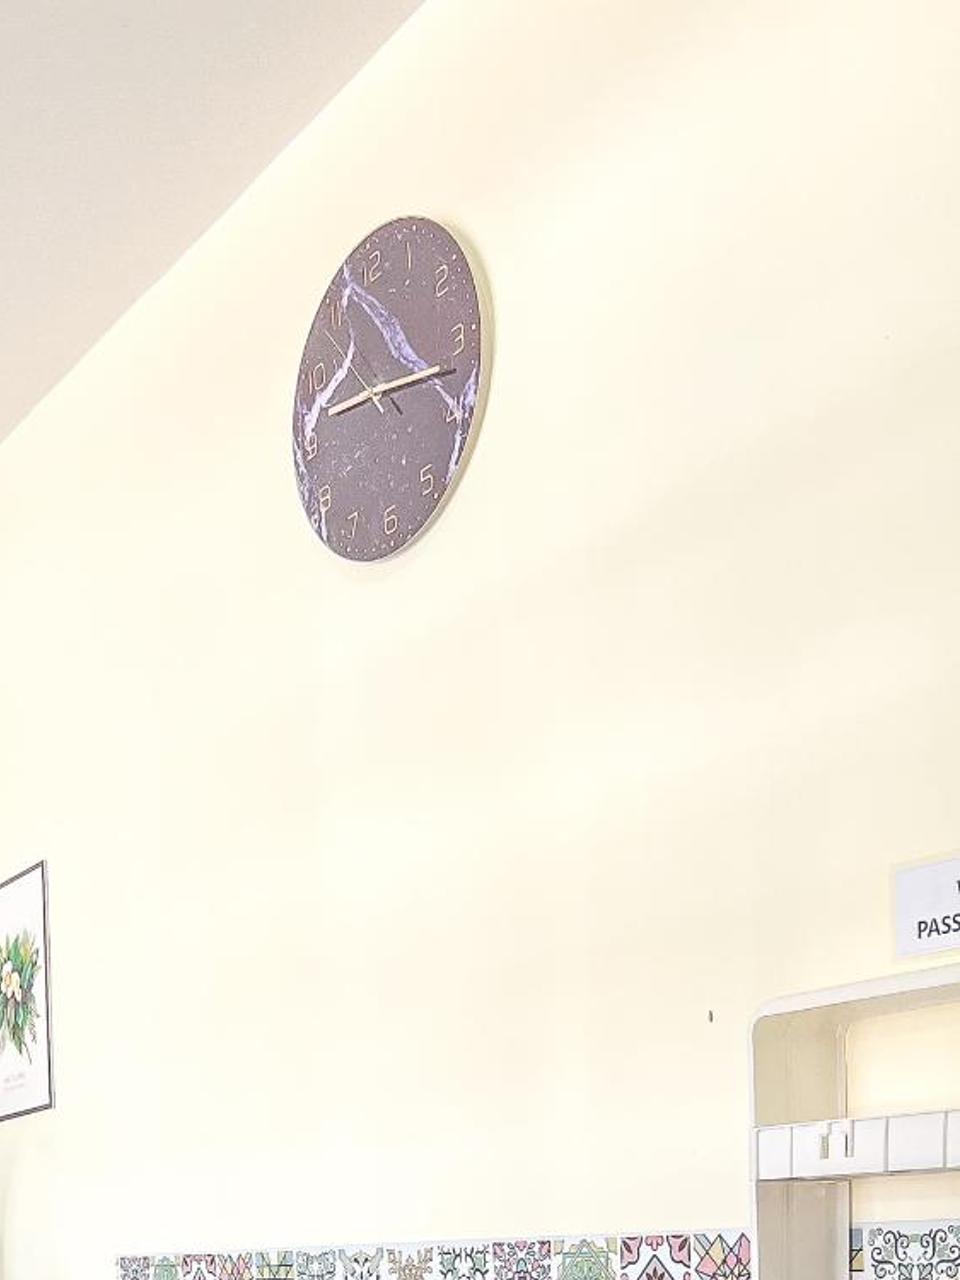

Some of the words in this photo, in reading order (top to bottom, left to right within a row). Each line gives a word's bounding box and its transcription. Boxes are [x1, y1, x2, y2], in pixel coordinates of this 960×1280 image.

[362, 250, 382, 288] 12
[435, 264, 449, 298] 2
[330, 300, 342, 330] 11
[450, 323, 465, 356] 3
[308, 362, 327, 395] 10
[442, 397, 462, 425] 4
[304, 431, 319, 462] 9
[419, 463, 435, 496] 5
[319, 484, 332, 513] 8
[346, 511, 359, 539] 7
[383, 504, 399, 535] 6
[917, 913, 960, 940] PASS
